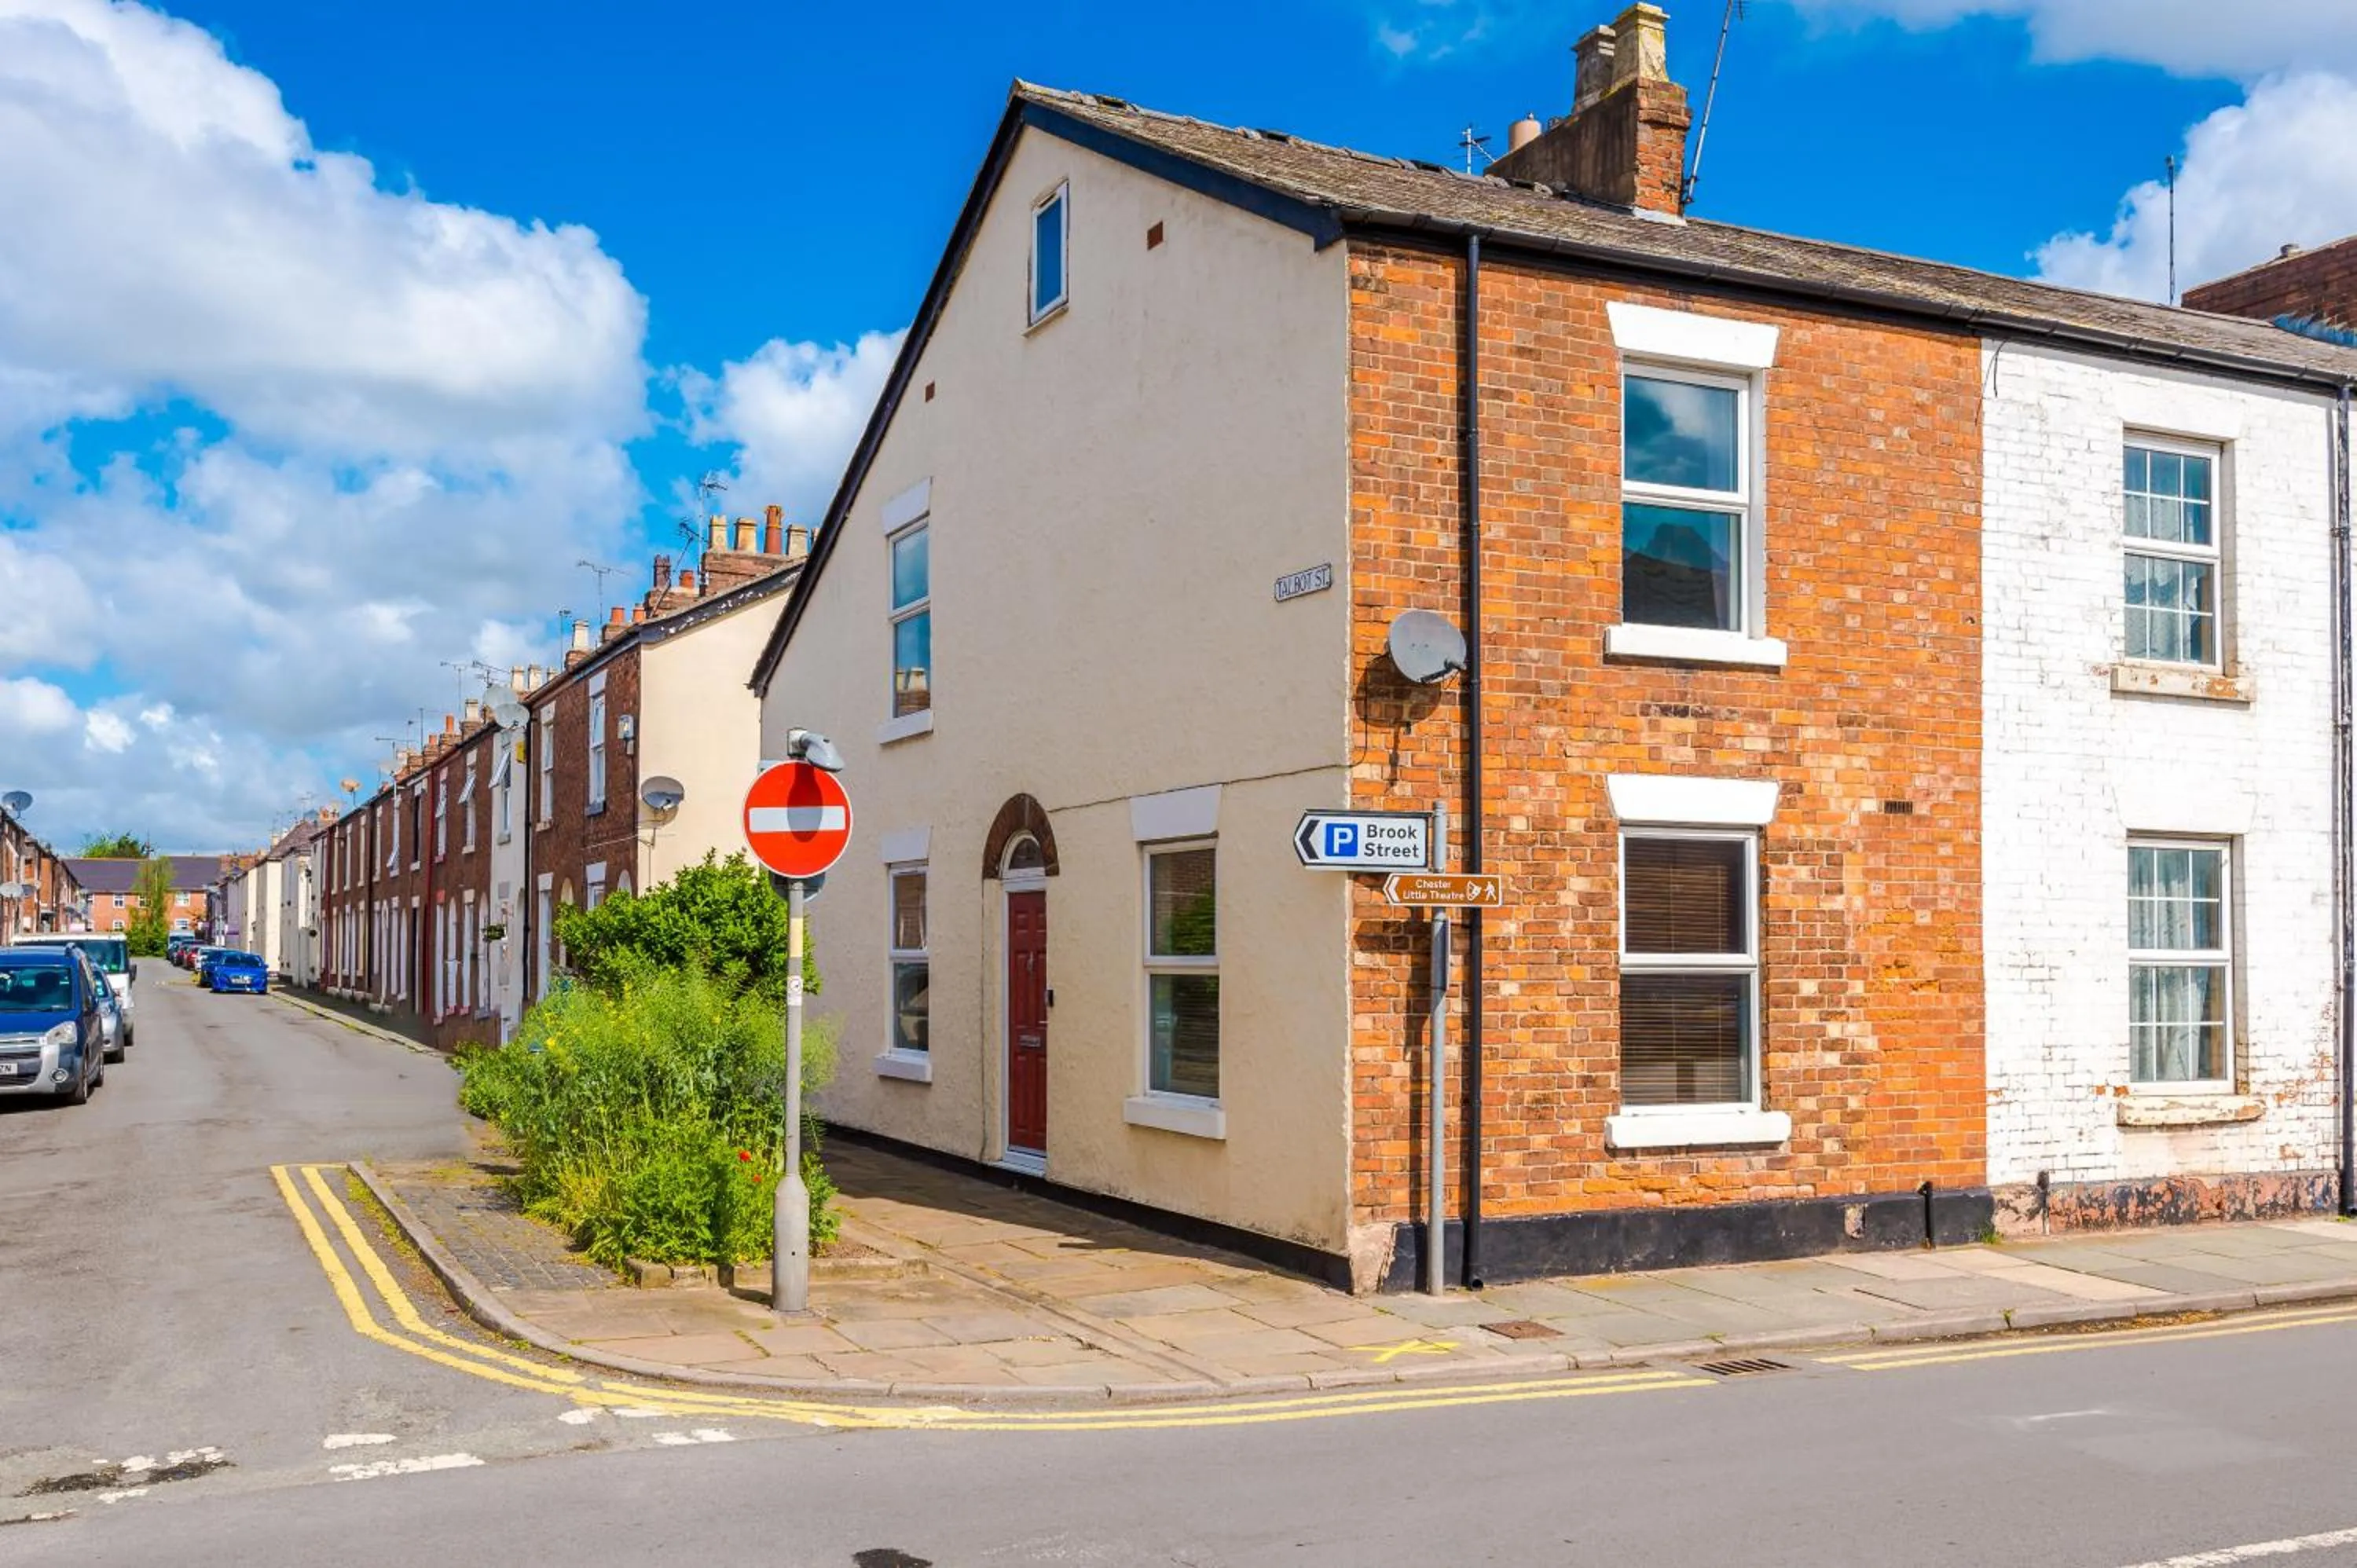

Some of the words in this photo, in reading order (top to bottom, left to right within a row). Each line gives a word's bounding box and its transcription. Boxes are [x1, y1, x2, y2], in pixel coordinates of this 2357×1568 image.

[1367, 824, 1417, 839] Brook
[1333, 827, 1353, 854] P
[1364, 842, 1419, 858] Street
[1415, 878, 1451, 888] Chester
[1402, 890, 1428, 899] Little
[1429, 890, 1464, 900] Theatre
